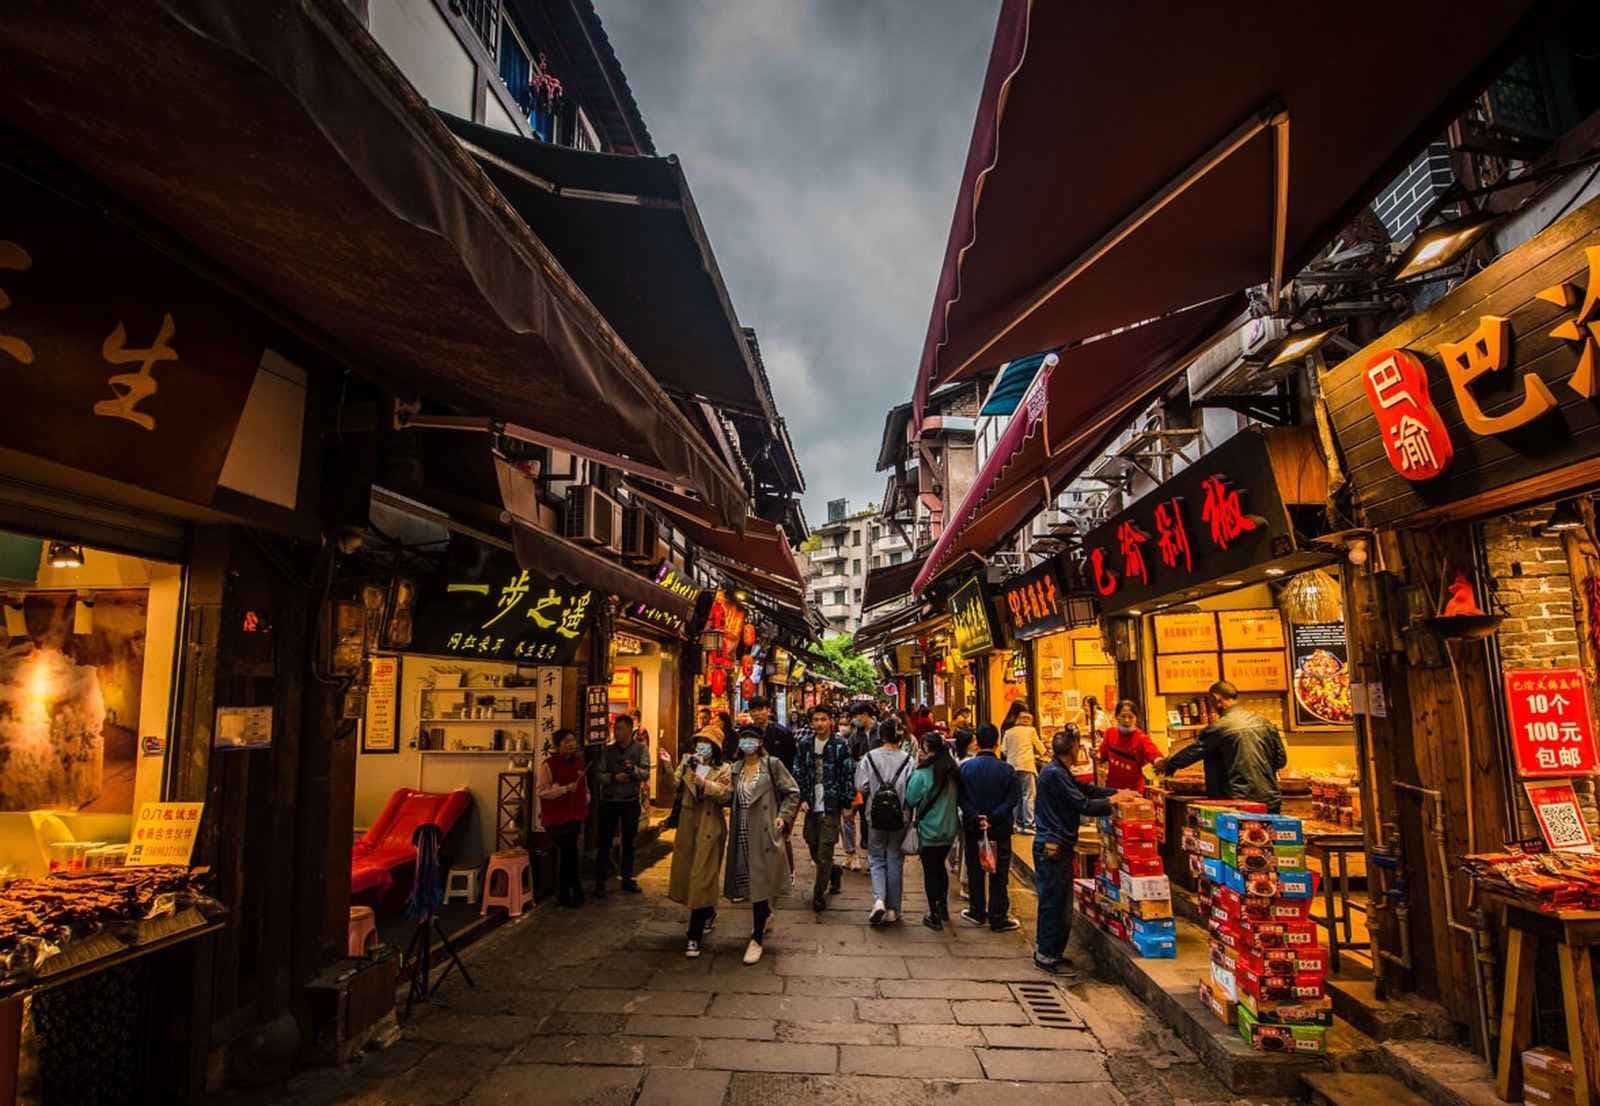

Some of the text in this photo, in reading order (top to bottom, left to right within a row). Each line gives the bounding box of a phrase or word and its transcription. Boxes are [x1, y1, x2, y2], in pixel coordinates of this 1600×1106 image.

[1369, 355, 1438, 471] 巴渝
[446, 568, 592, 639] 一步之遥
[1526, 694, 1570, 715] 10个
[1524, 721, 1583, 743] 100元
[1536, 746, 1582, 768] 包邮
